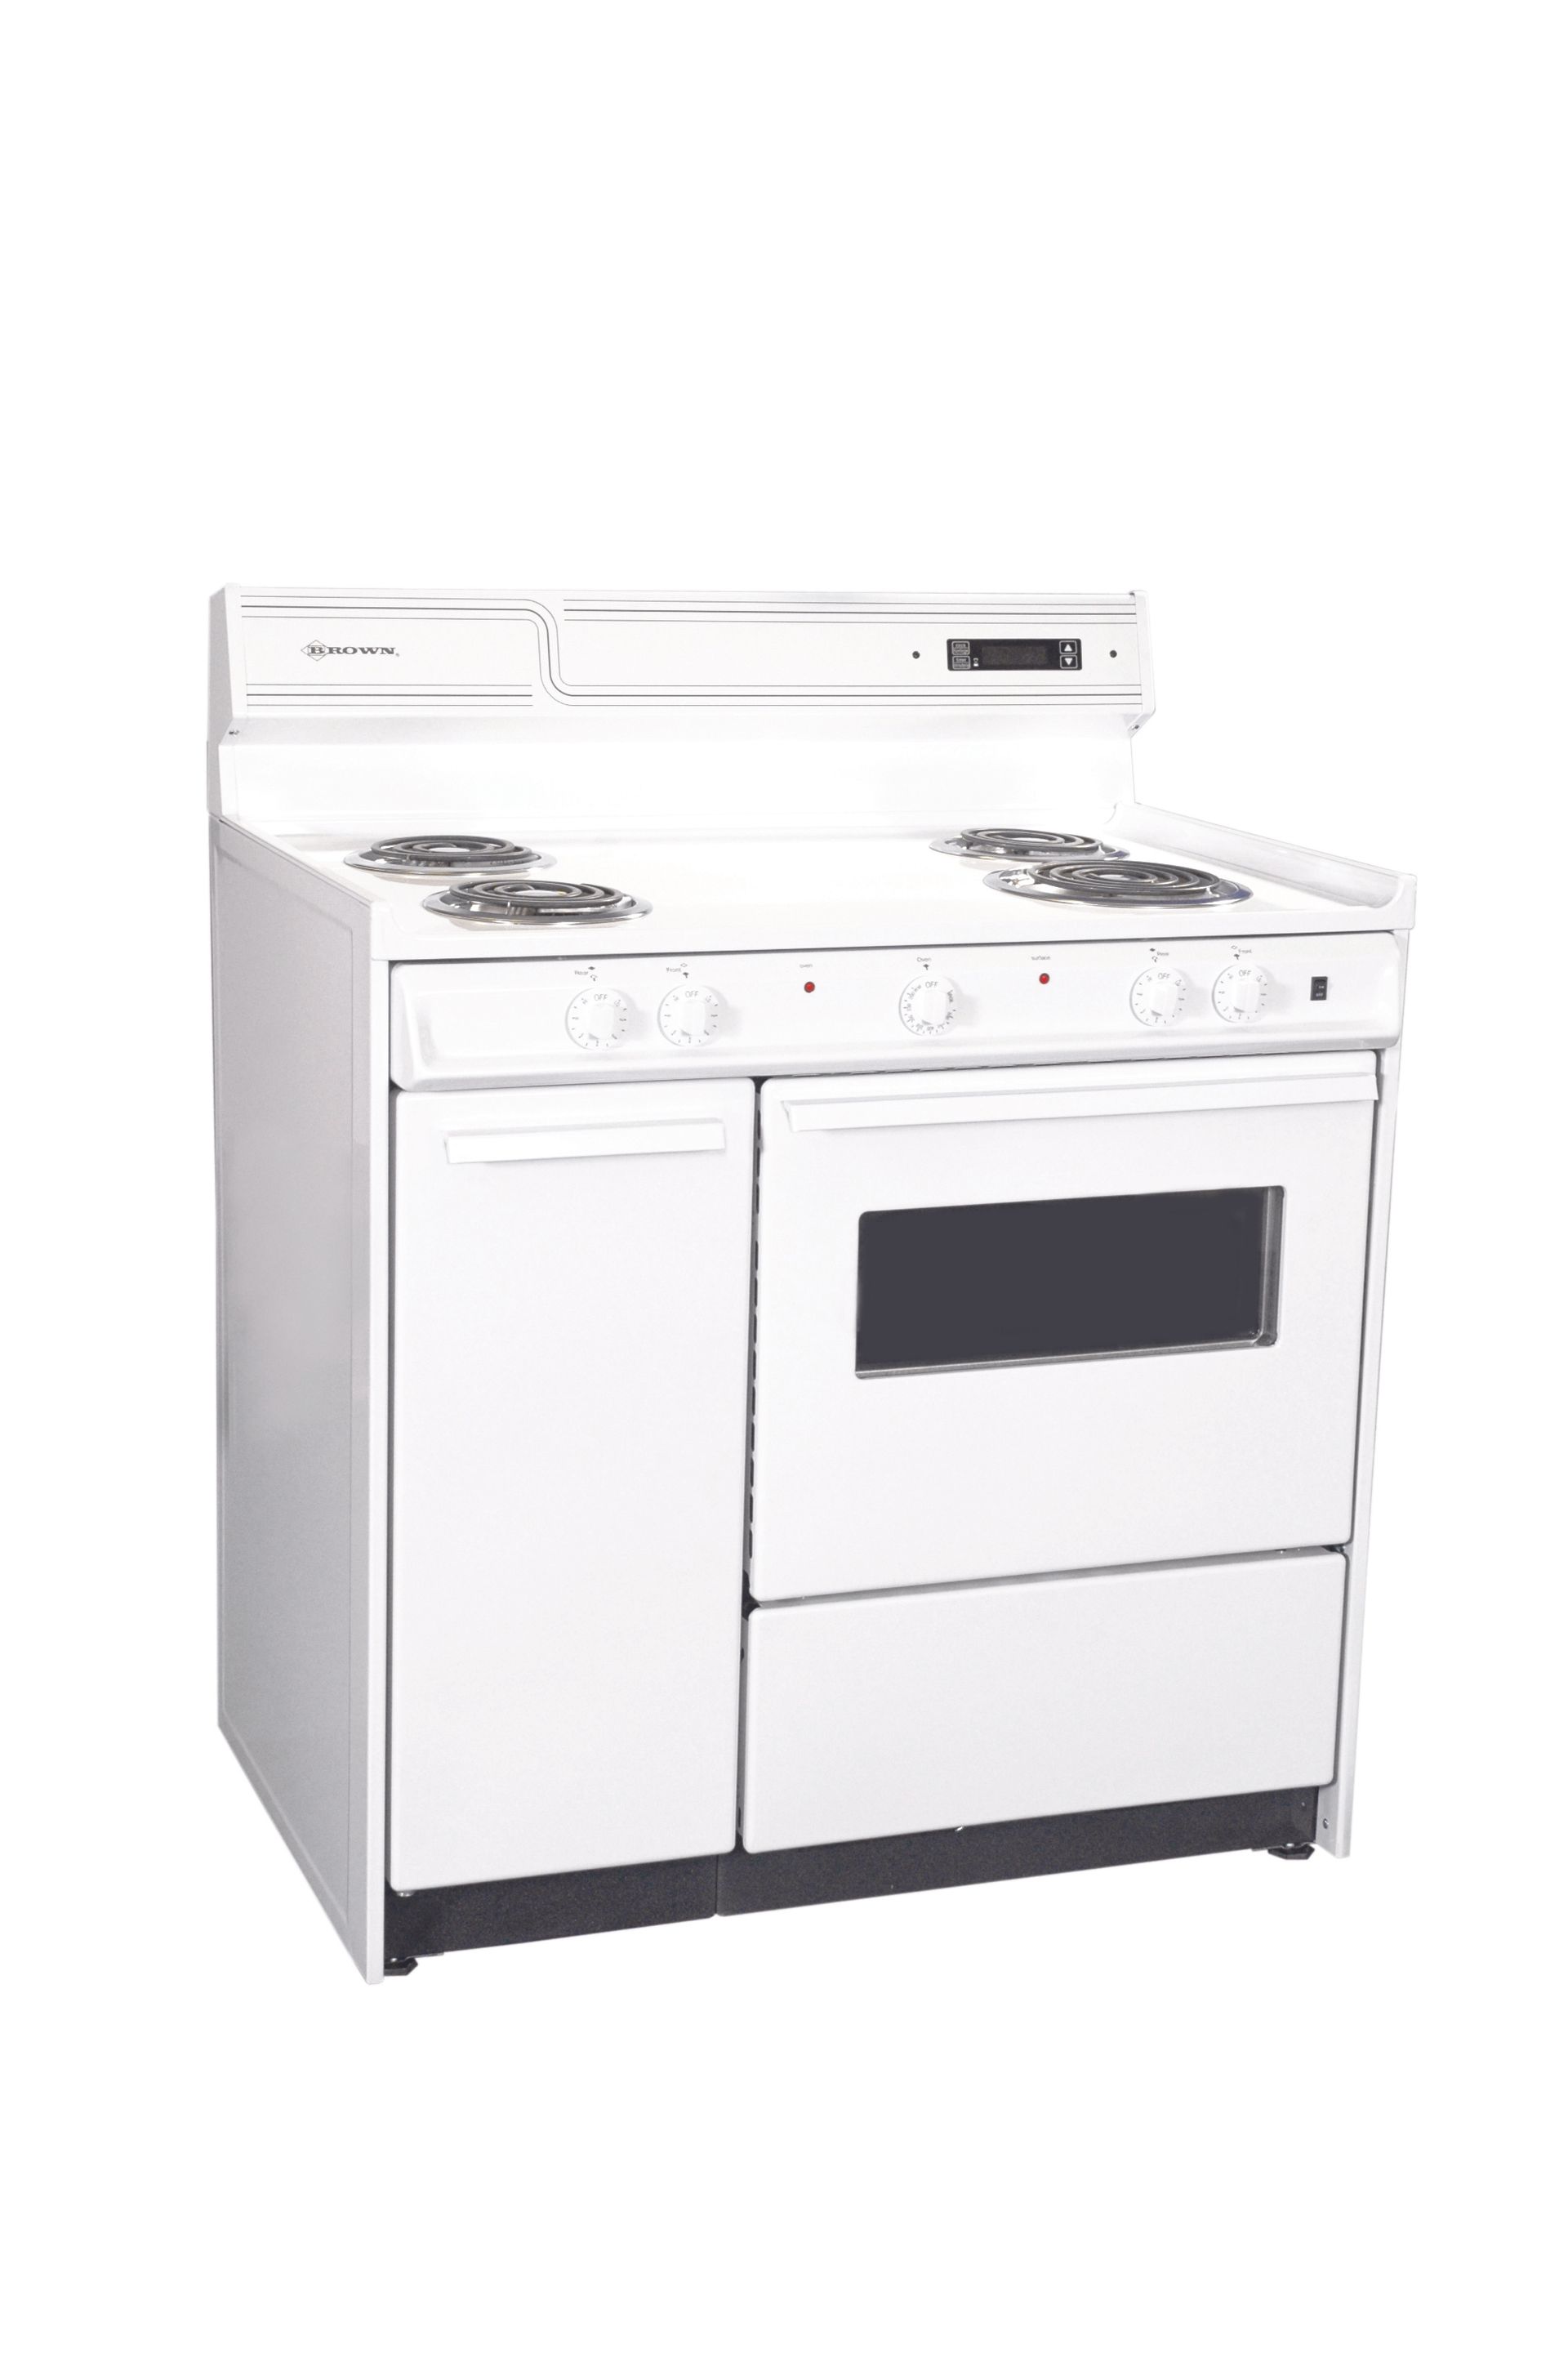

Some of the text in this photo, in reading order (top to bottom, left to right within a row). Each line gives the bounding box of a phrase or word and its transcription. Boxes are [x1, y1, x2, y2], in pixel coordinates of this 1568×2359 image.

[309, 645, 396, 655] BROWN
[1157, 972, 1170, 980] OFF
[1238, 969, 1252, 977] OFF
[924, 980, 938, 988] OFF
[594, 993, 608, 1001] OFF
[684, 989, 699, 998] OFF
